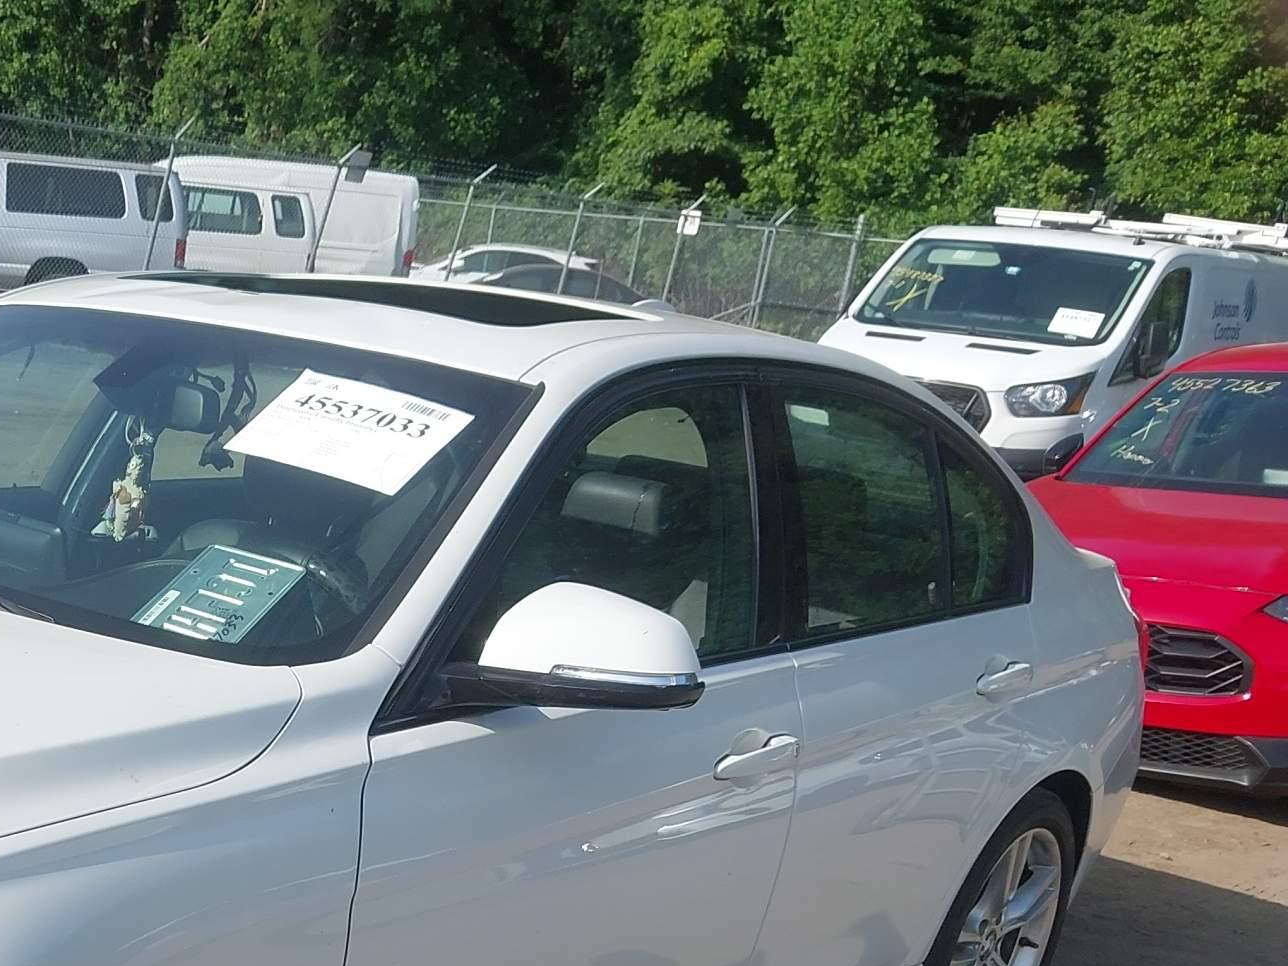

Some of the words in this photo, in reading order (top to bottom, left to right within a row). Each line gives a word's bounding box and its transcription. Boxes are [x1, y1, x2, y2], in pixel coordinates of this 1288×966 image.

[1212, 299, 1240, 320] Johnson
[1214, 321, 1241, 341] Controls
[295, 393, 431, 439] 45537033
